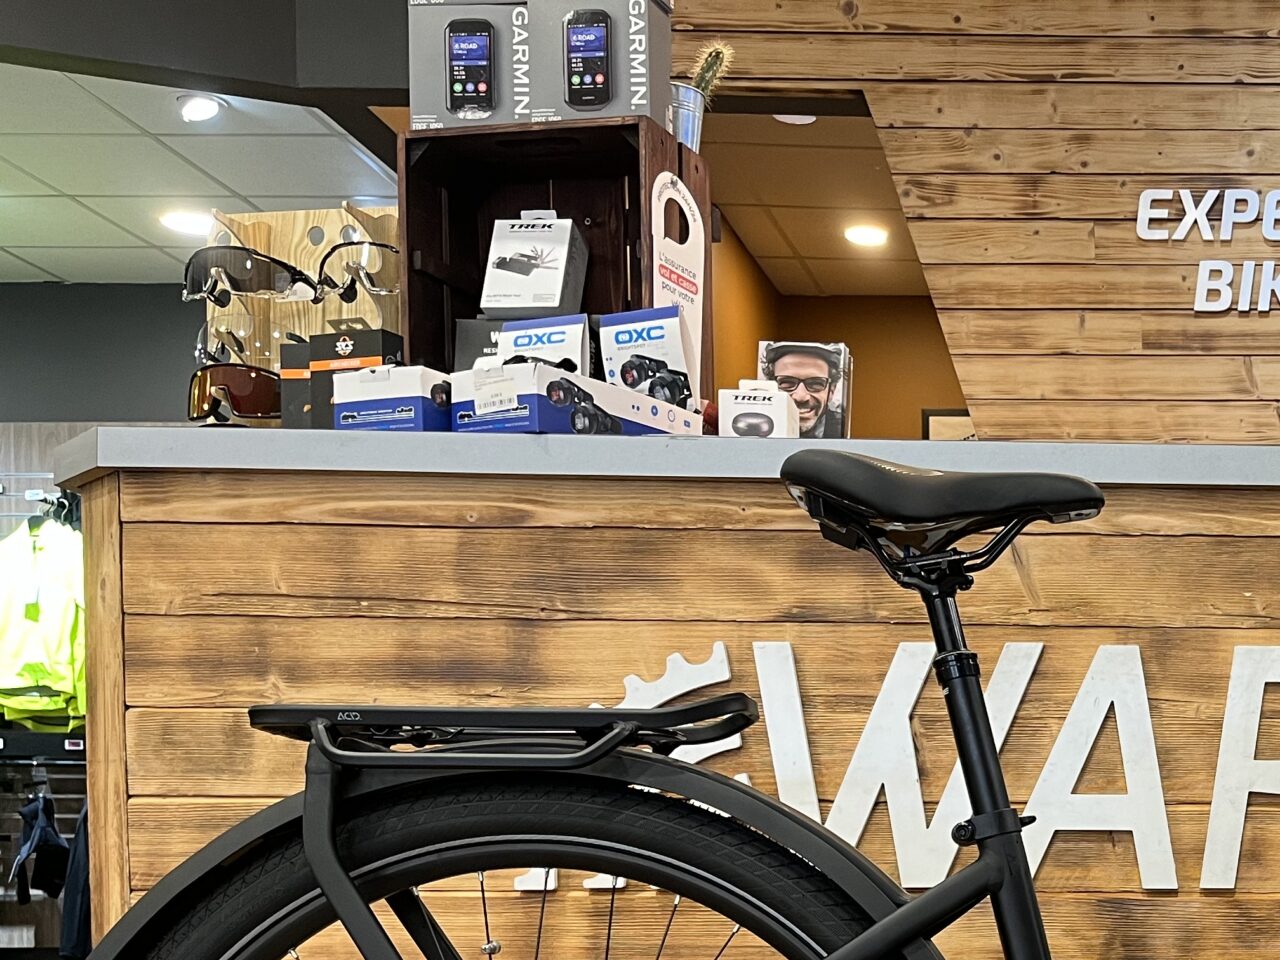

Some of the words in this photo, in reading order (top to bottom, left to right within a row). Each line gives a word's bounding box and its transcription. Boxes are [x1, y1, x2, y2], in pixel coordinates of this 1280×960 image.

[508, 223, 555, 231] TREK
[513, 331, 567, 348] OXC
[614, 325, 666, 345] OXC
[731, 394, 775, 402] TREK
